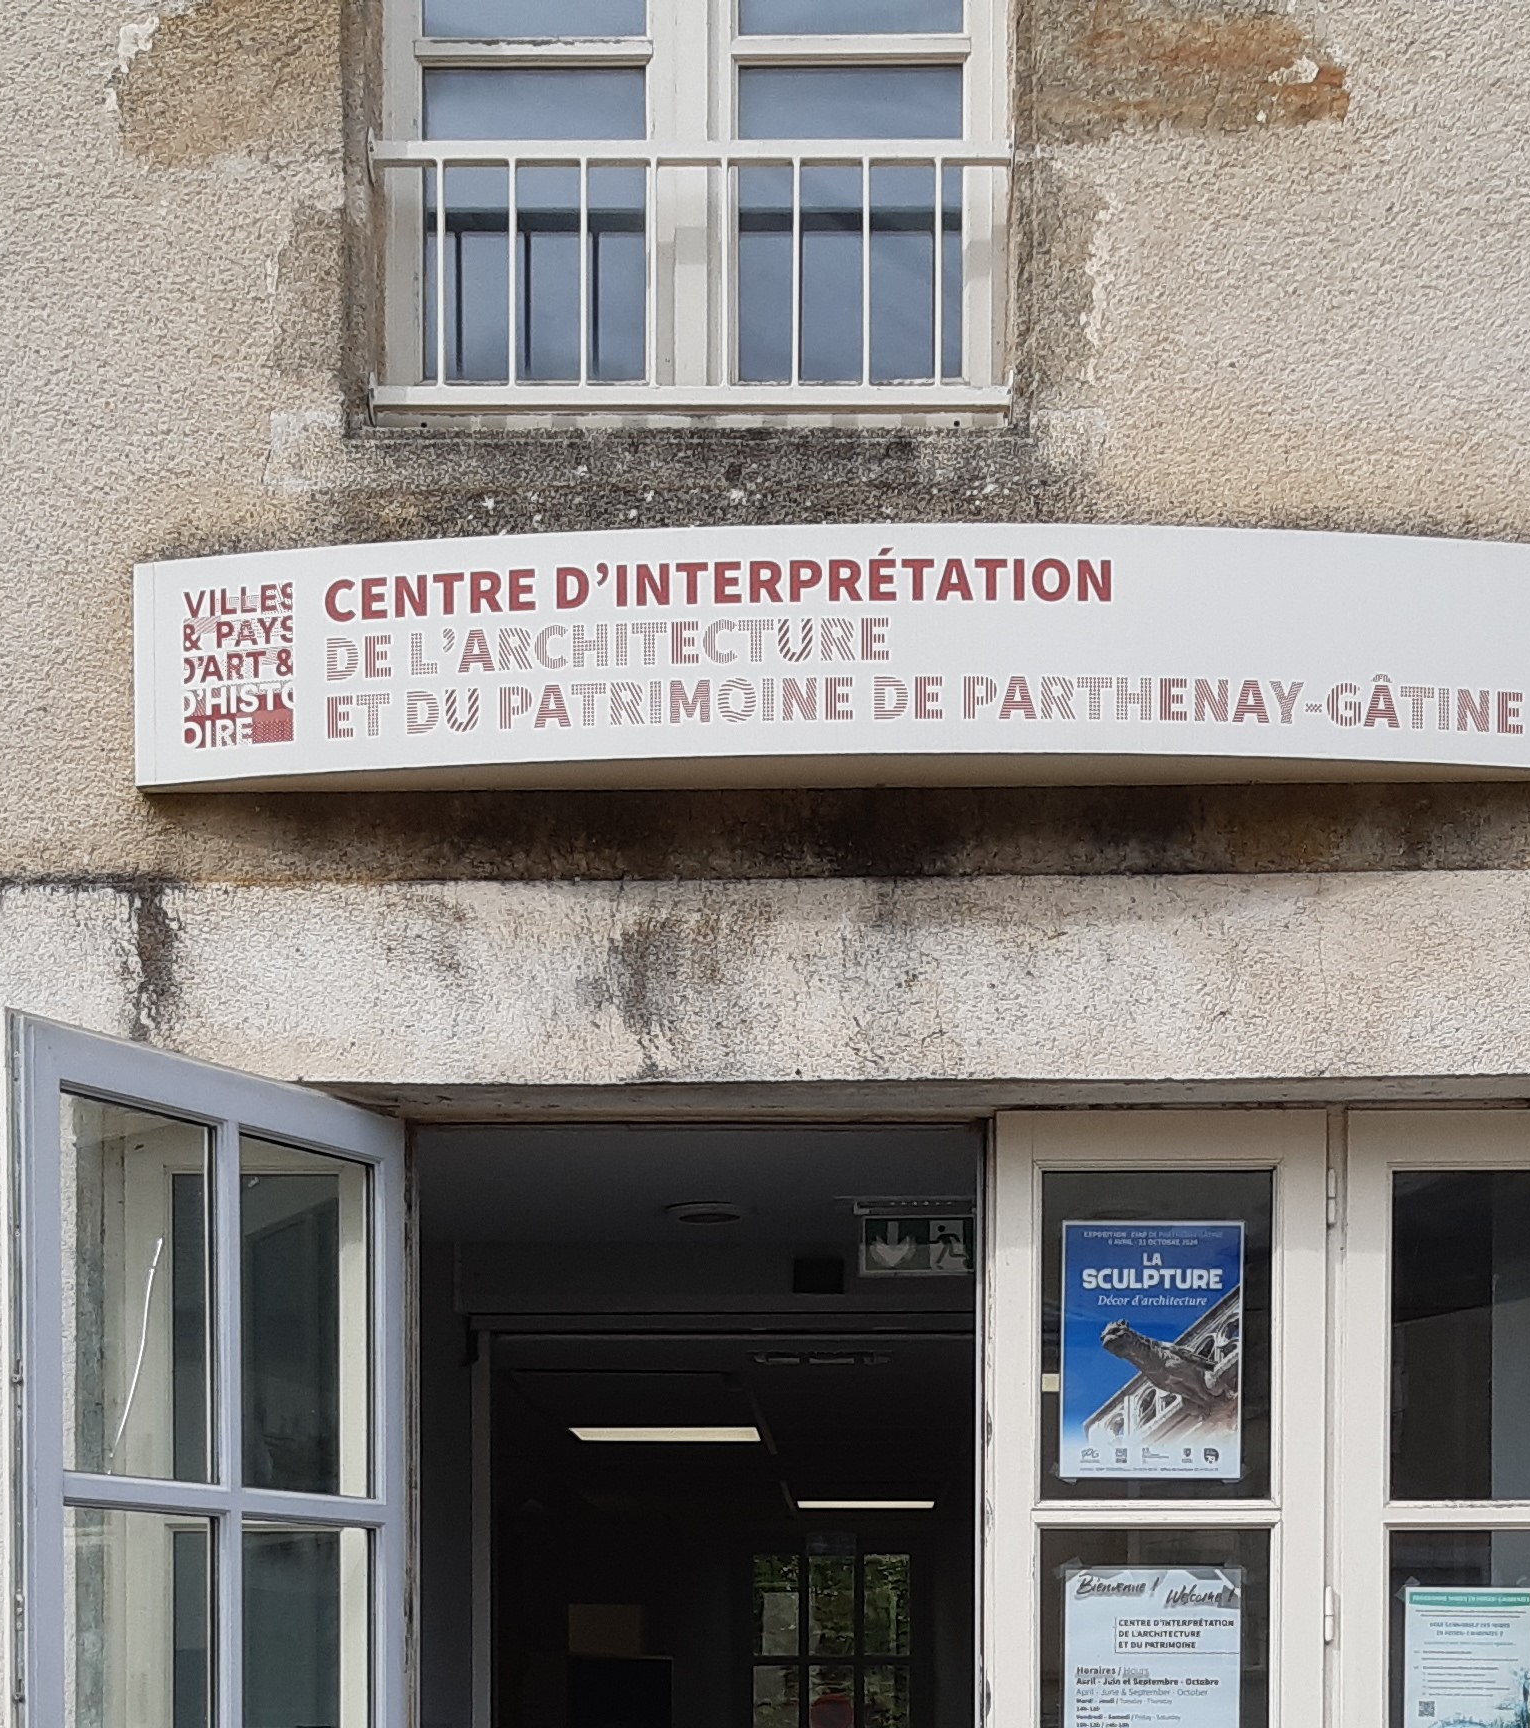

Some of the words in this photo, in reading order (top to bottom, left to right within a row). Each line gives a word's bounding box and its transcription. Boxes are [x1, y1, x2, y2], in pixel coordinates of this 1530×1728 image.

[324, 568, 536, 622] CENTRE
[556, 547, 1112, 609] D'INTERPRÉTATION
[183, 582, 293, 618] VILLES
[183, 623, 202, 650] &
[216, 615, 293, 648] PAYS
[326, 634, 392, 681] DE
[410, 617, 890, 675] L'ARCHITECTURE
[275, 649, 293, 677] &
[326, 692, 391, 739] ET
[406, 687, 480, 734] DU
[499, 677, 854, 730] PATRIMOINE
[873, 675, 943, 721] DE
[963, 673, 1525, 736] PARTHENAY-GÂTINE
[183, 716, 253, 749] OIRE
[1142, 1252, 1162, 1266] LA
[1082, 1268, 1223, 1289] SCULPTURE
[1097, 1293, 1129, 1306] Décor
[1131, 1294, 1207, 1306] d'architecture
[1076, 1574, 1146, 1595] Bienvenue
[1165, 1584, 1222, 1604] Welcome
[1119, 1619, 1151, 1627] CENTRE
[1153, 1617, 1234, 1627] D'INTERPRÉTATION
[1118, 1630, 1130, 1638] DE
[1118, 1641, 1128, 1649] ET
[1130, 1641, 1143, 1649] DU
[1145, 1641, 1196, 1649] PATRIMOINE
[1076, 1666, 1116, 1675] Horaires
[1076, 1677, 1096, 1685] Avril
[1103, 1677, 1120, 1685] Juin
[1133, 1678, 1179, 1687] Septembre
[1185, 1678, 1219, 1686] Octobre
[1129, 1688, 1171, 1697] September
[1177, 1688, 1208, 1696] October
